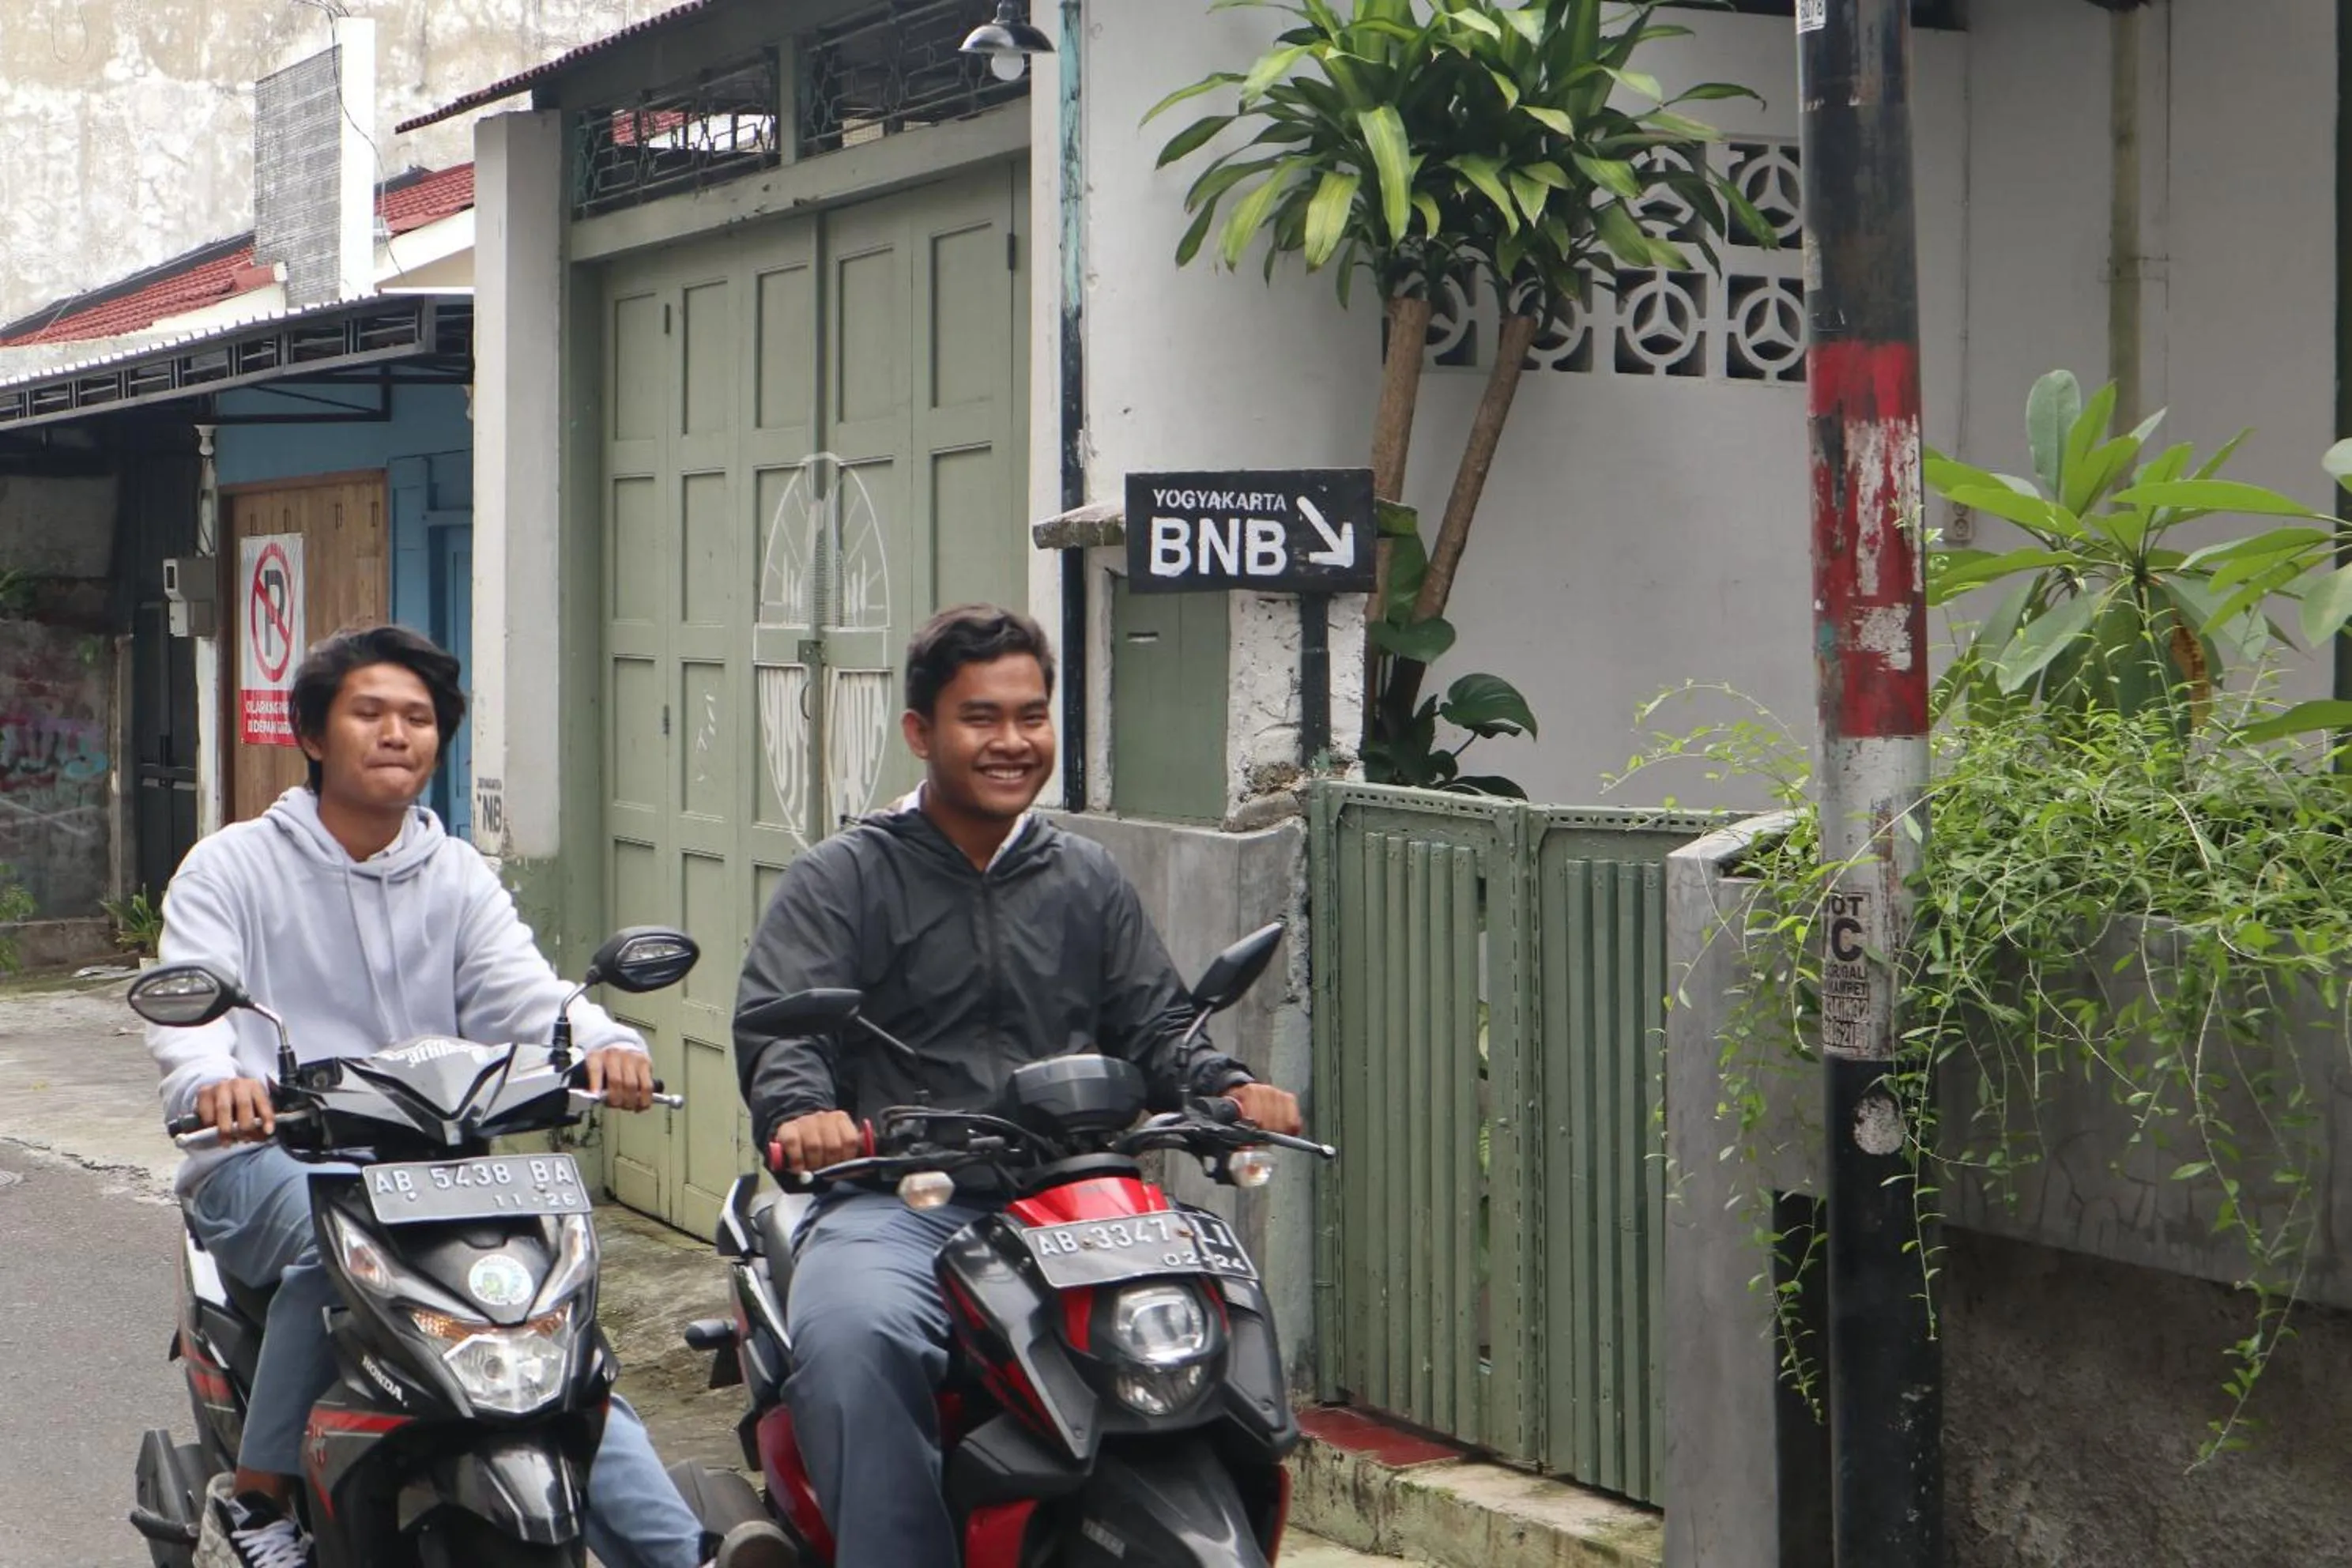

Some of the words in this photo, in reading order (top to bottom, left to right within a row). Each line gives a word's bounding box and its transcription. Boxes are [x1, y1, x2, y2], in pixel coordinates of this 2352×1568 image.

[1152, 488, 1287, 511] YOGYAKARTA
[1149, 516, 1288, 578] BNB
[374, 1170, 413, 1194] AB
[429, 1163, 511, 1189] 5438
[529, 1159, 574, 1185] BA
[1036, 1229, 1080, 1257] AB
[1088, 1218, 1170, 1249] 3347
[361, 1354, 403, 1402] HONDA
